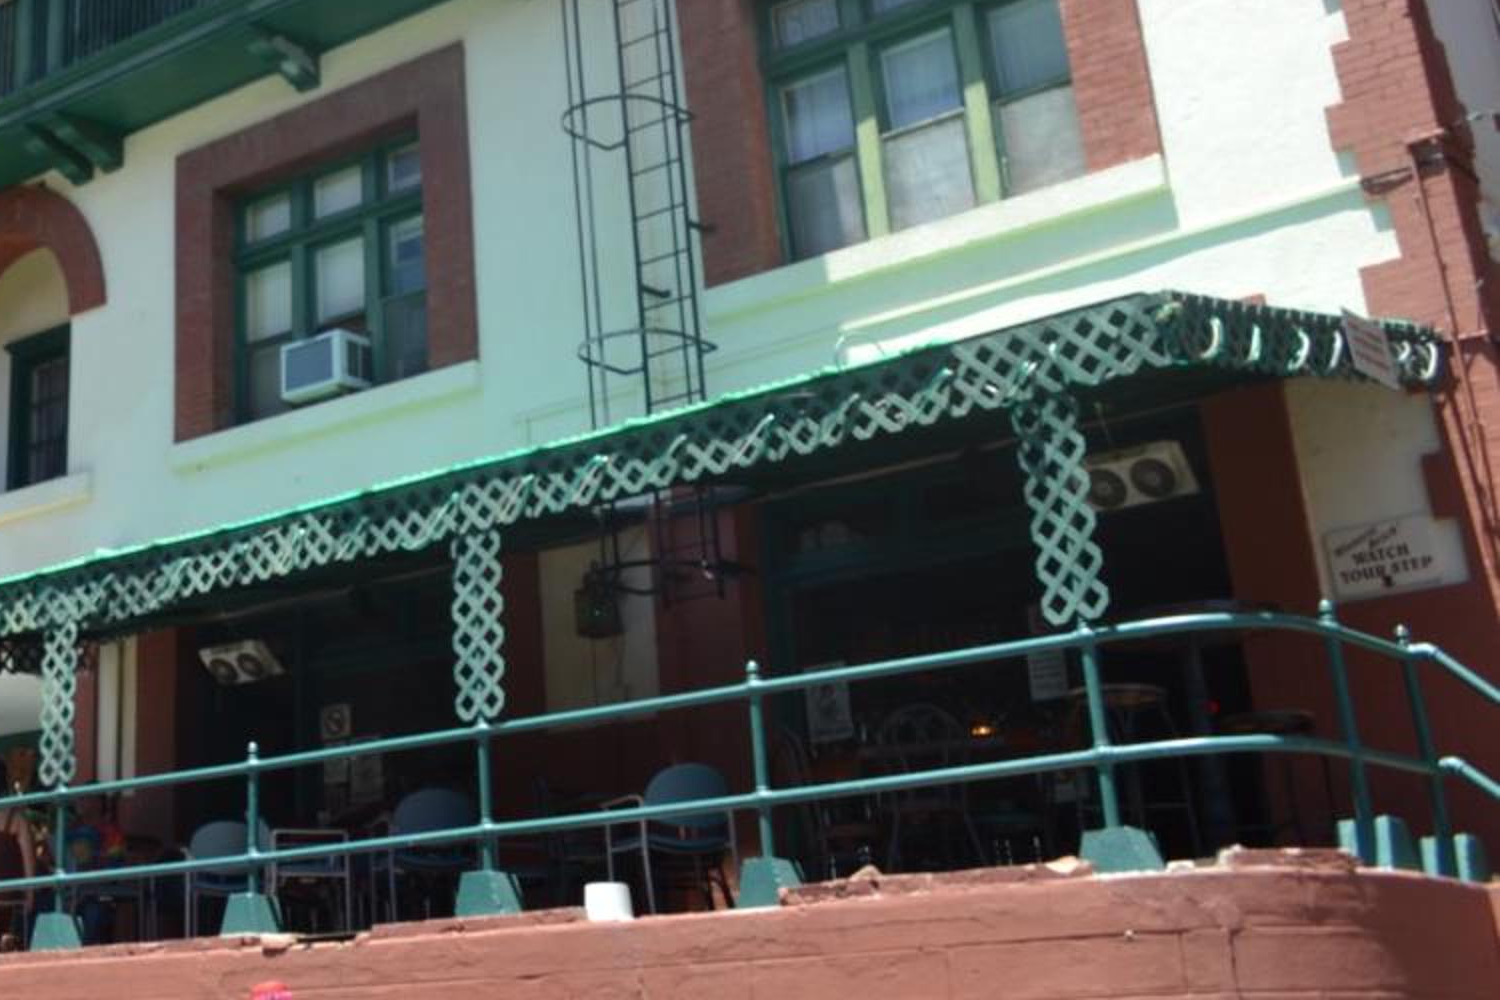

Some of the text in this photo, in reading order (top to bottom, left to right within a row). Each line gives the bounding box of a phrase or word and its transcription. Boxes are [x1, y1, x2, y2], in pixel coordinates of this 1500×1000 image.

[1351, 542, 1410, 565] WATCH
[1339, 554, 1433, 585] YOUR STEP
